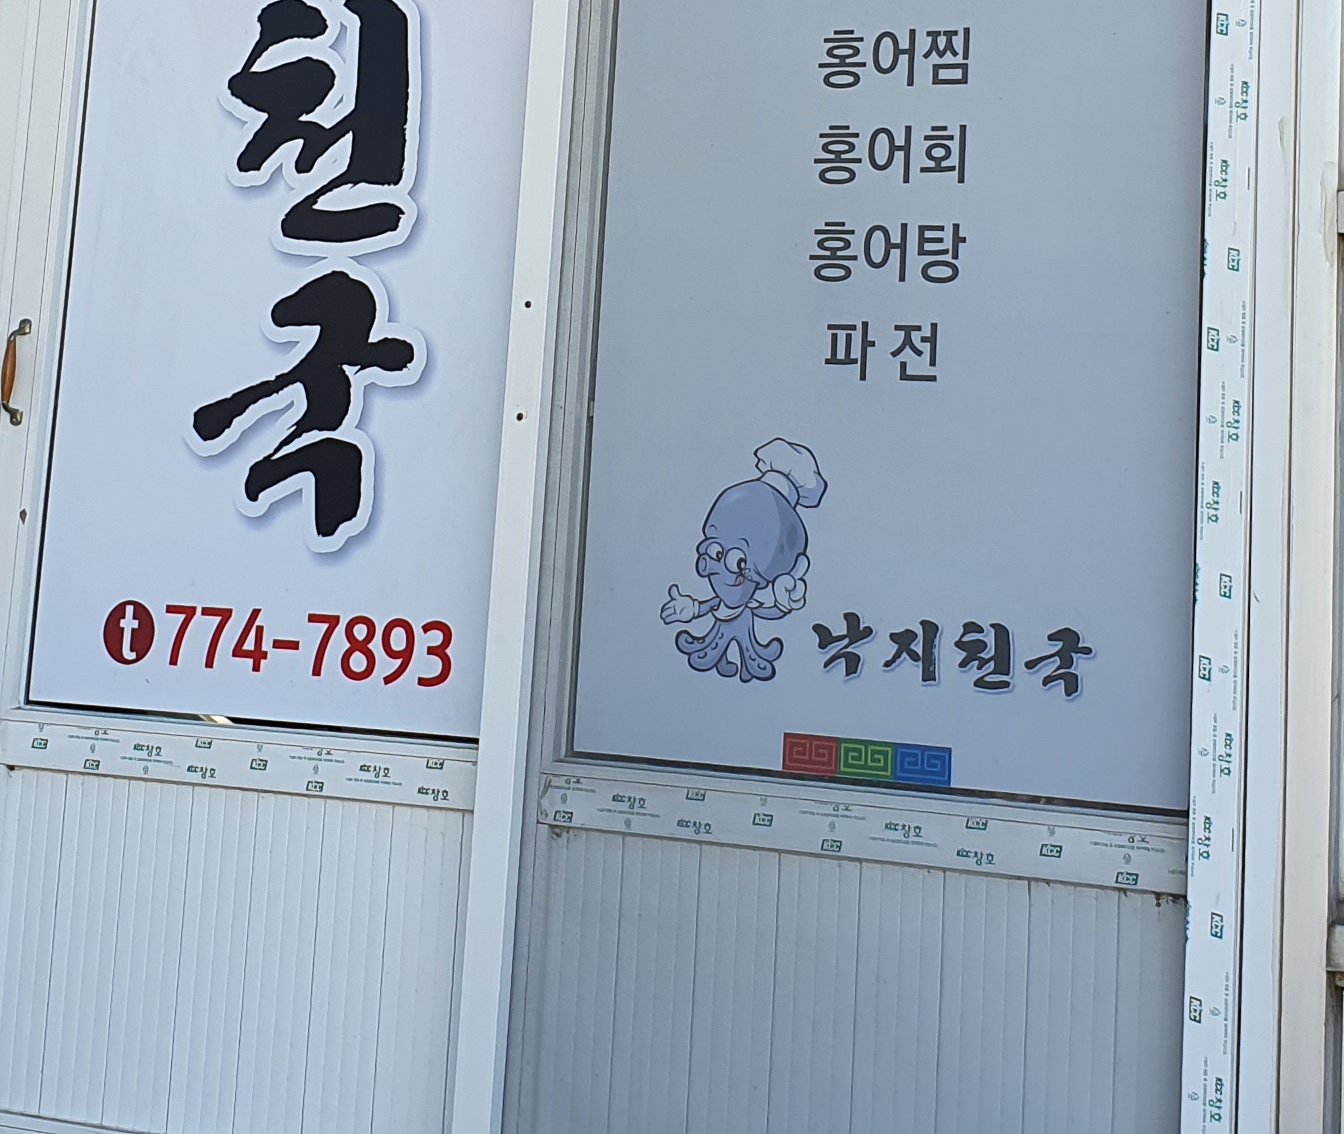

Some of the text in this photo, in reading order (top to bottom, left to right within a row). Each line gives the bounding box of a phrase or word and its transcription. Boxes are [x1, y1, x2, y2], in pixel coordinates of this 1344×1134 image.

[818, 27, 971, 89] 홍어찜
[814, 124, 967, 185] 홍어회
[809, 221, 967, 283] 홍어탕
[163, 603, 454, 688] 774-7893
[812, 612, 1093, 697] 낙지천국
